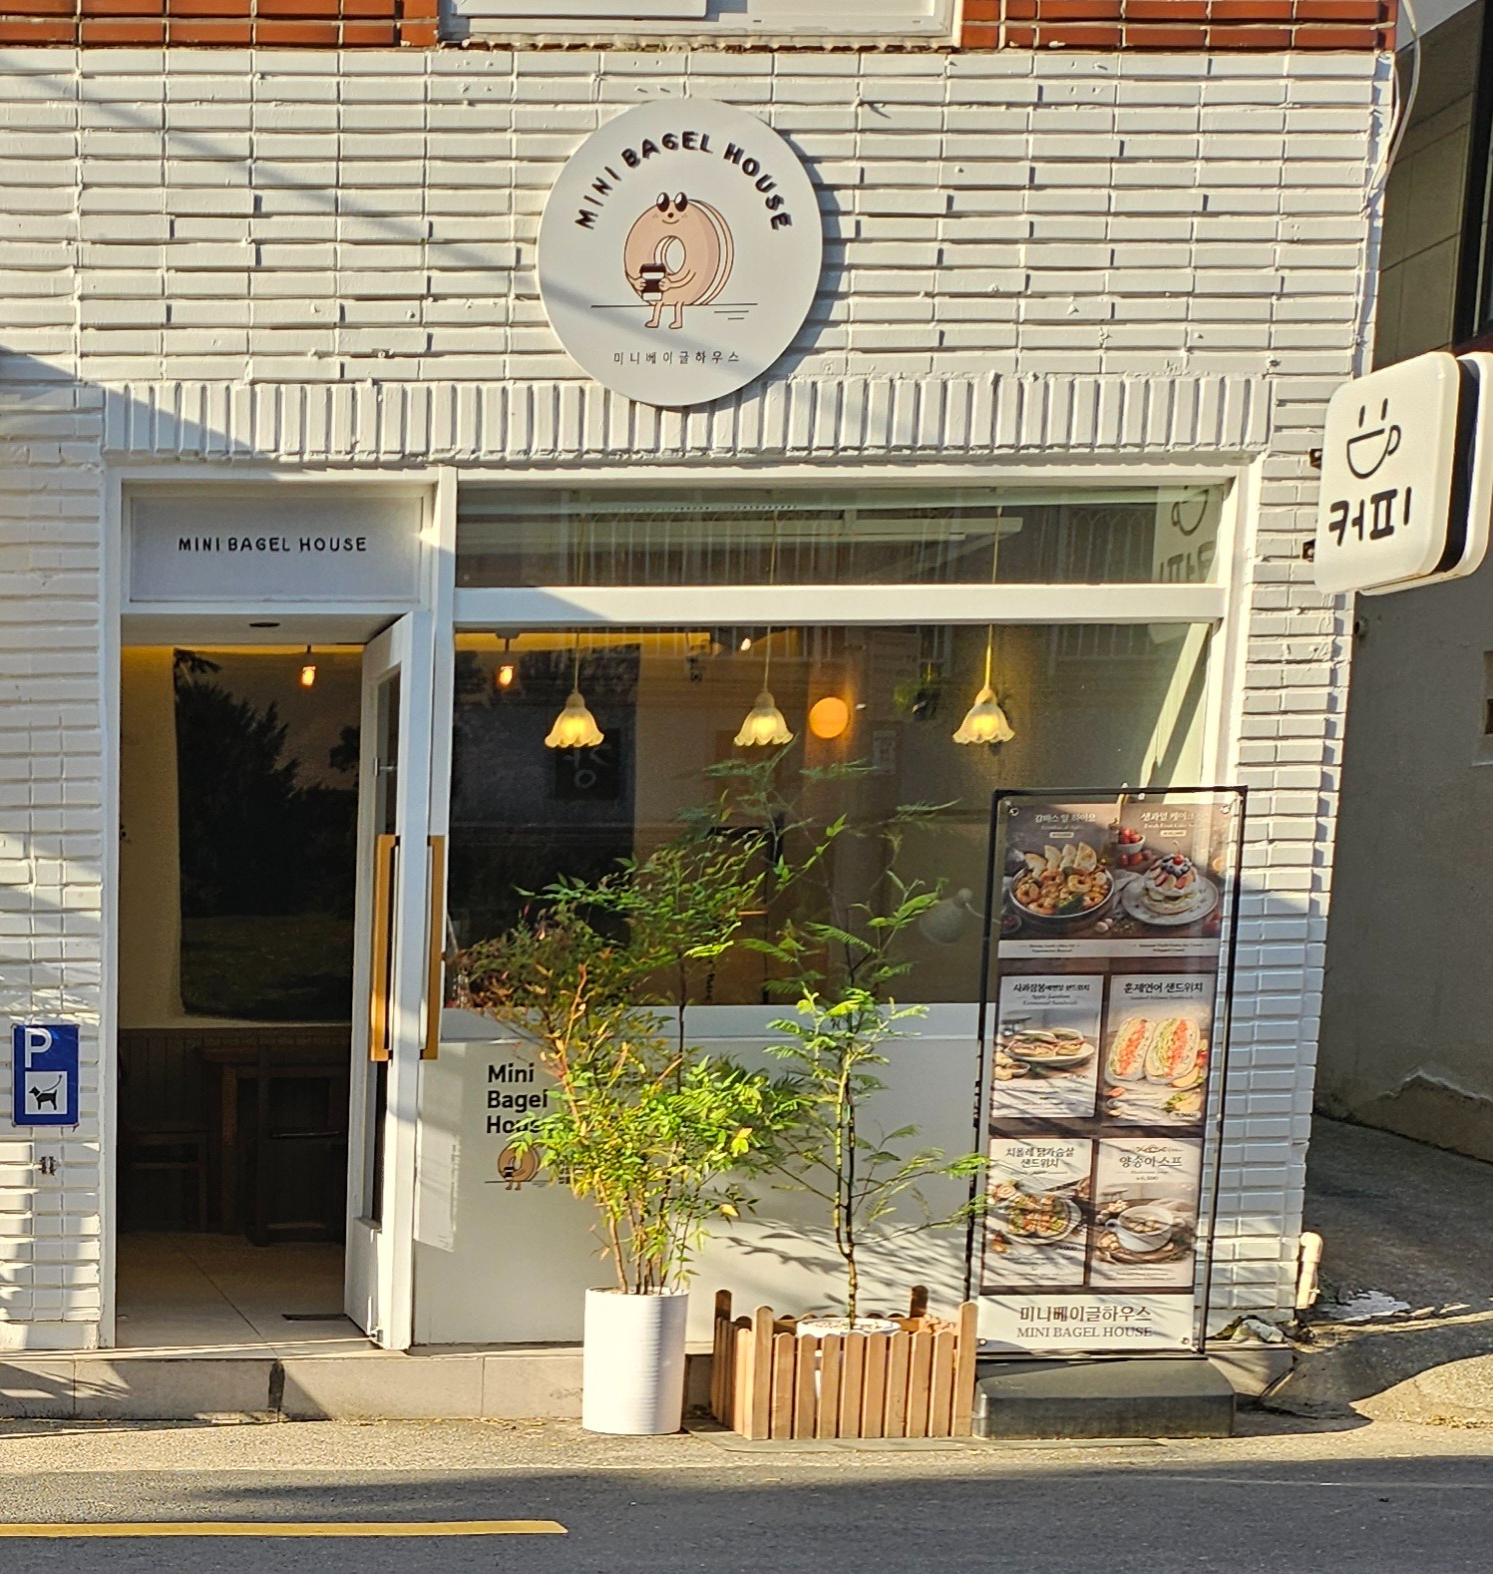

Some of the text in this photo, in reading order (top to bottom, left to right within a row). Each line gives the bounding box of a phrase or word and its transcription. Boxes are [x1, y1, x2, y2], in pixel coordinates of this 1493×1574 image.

[575, 131, 793, 230] MINI BAGEL HOUSE
[613, 350, 739, 365] 미니베이글하우스
[1328, 486, 1412, 547] 커피
[178, 537, 367, 551] MINI BAGEL HOUSE
[1124, 982, 1204, 994] 훈제연어 샌드위치
[25, 1027, 52, 1068] P
[487, 1063, 534, 1083] Mini
[487, 1089, 548, 1113] Bagel
[486, 1115, 544, 1134] Hous
[1021, 1158, 1059, 1168] 샌드위치
[1020, 1306, 1152, 1322] 미니베이글하우스
[1017, 1327, 1154, 1337] MINI BAGEL HOUSE
